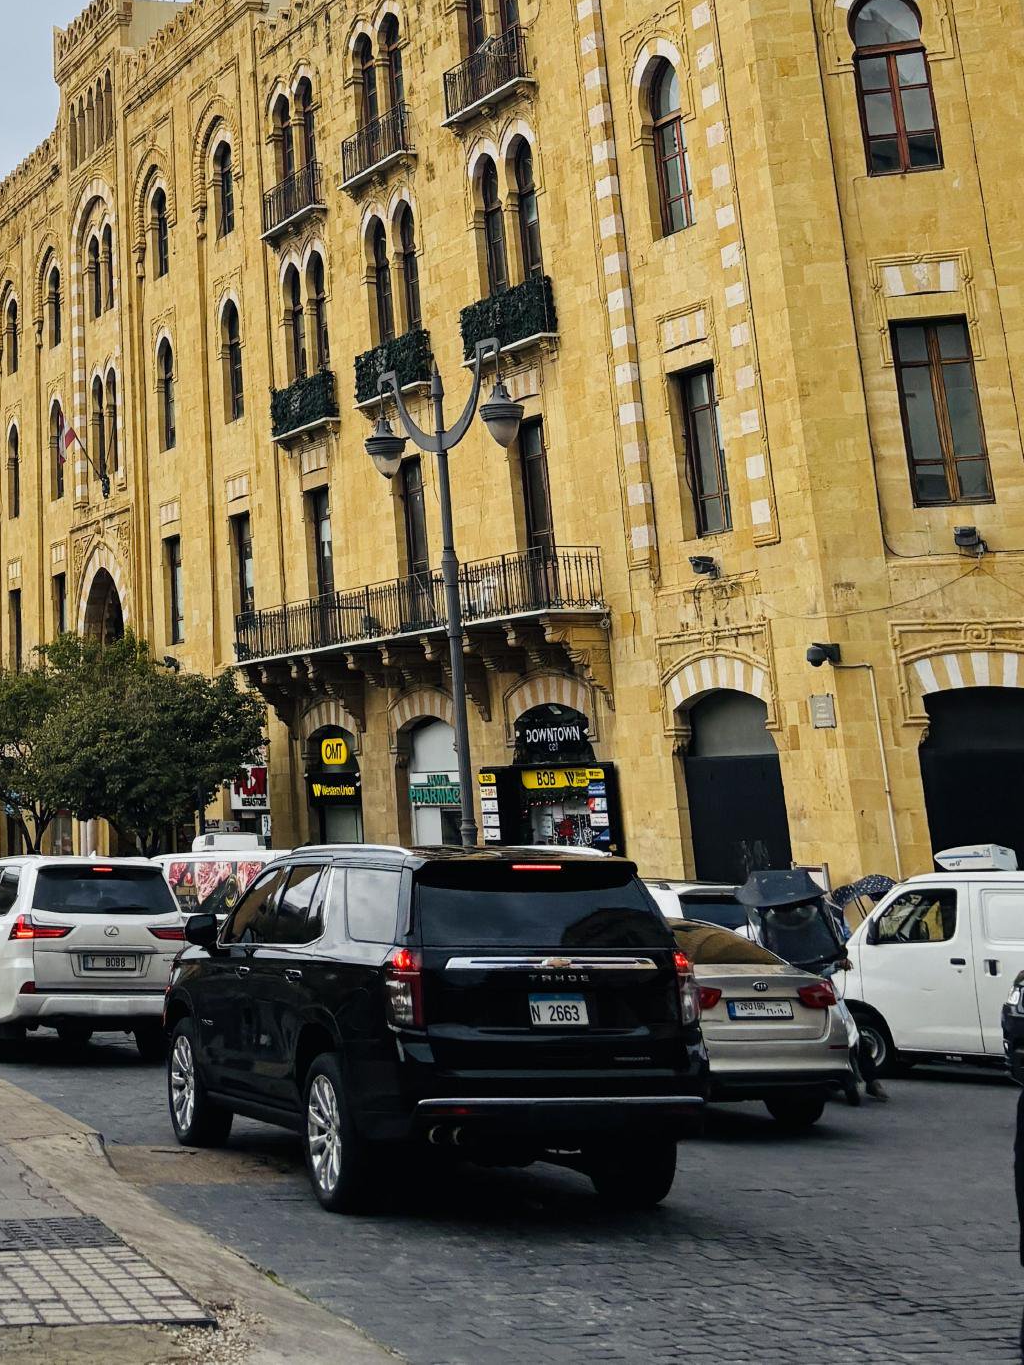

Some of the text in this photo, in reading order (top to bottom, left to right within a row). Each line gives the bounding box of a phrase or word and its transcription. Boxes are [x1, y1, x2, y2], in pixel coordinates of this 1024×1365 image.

[526, 726, 580, 743] DOWNTOWN
[325, 743, 342, 760] OMT
[537, 771, 556, 785] BOB
[410, 788, 461, 804] PHARMAC
[205, 819, 220, 828] LAY
[531, 1005, 580, 1022] N 2663
